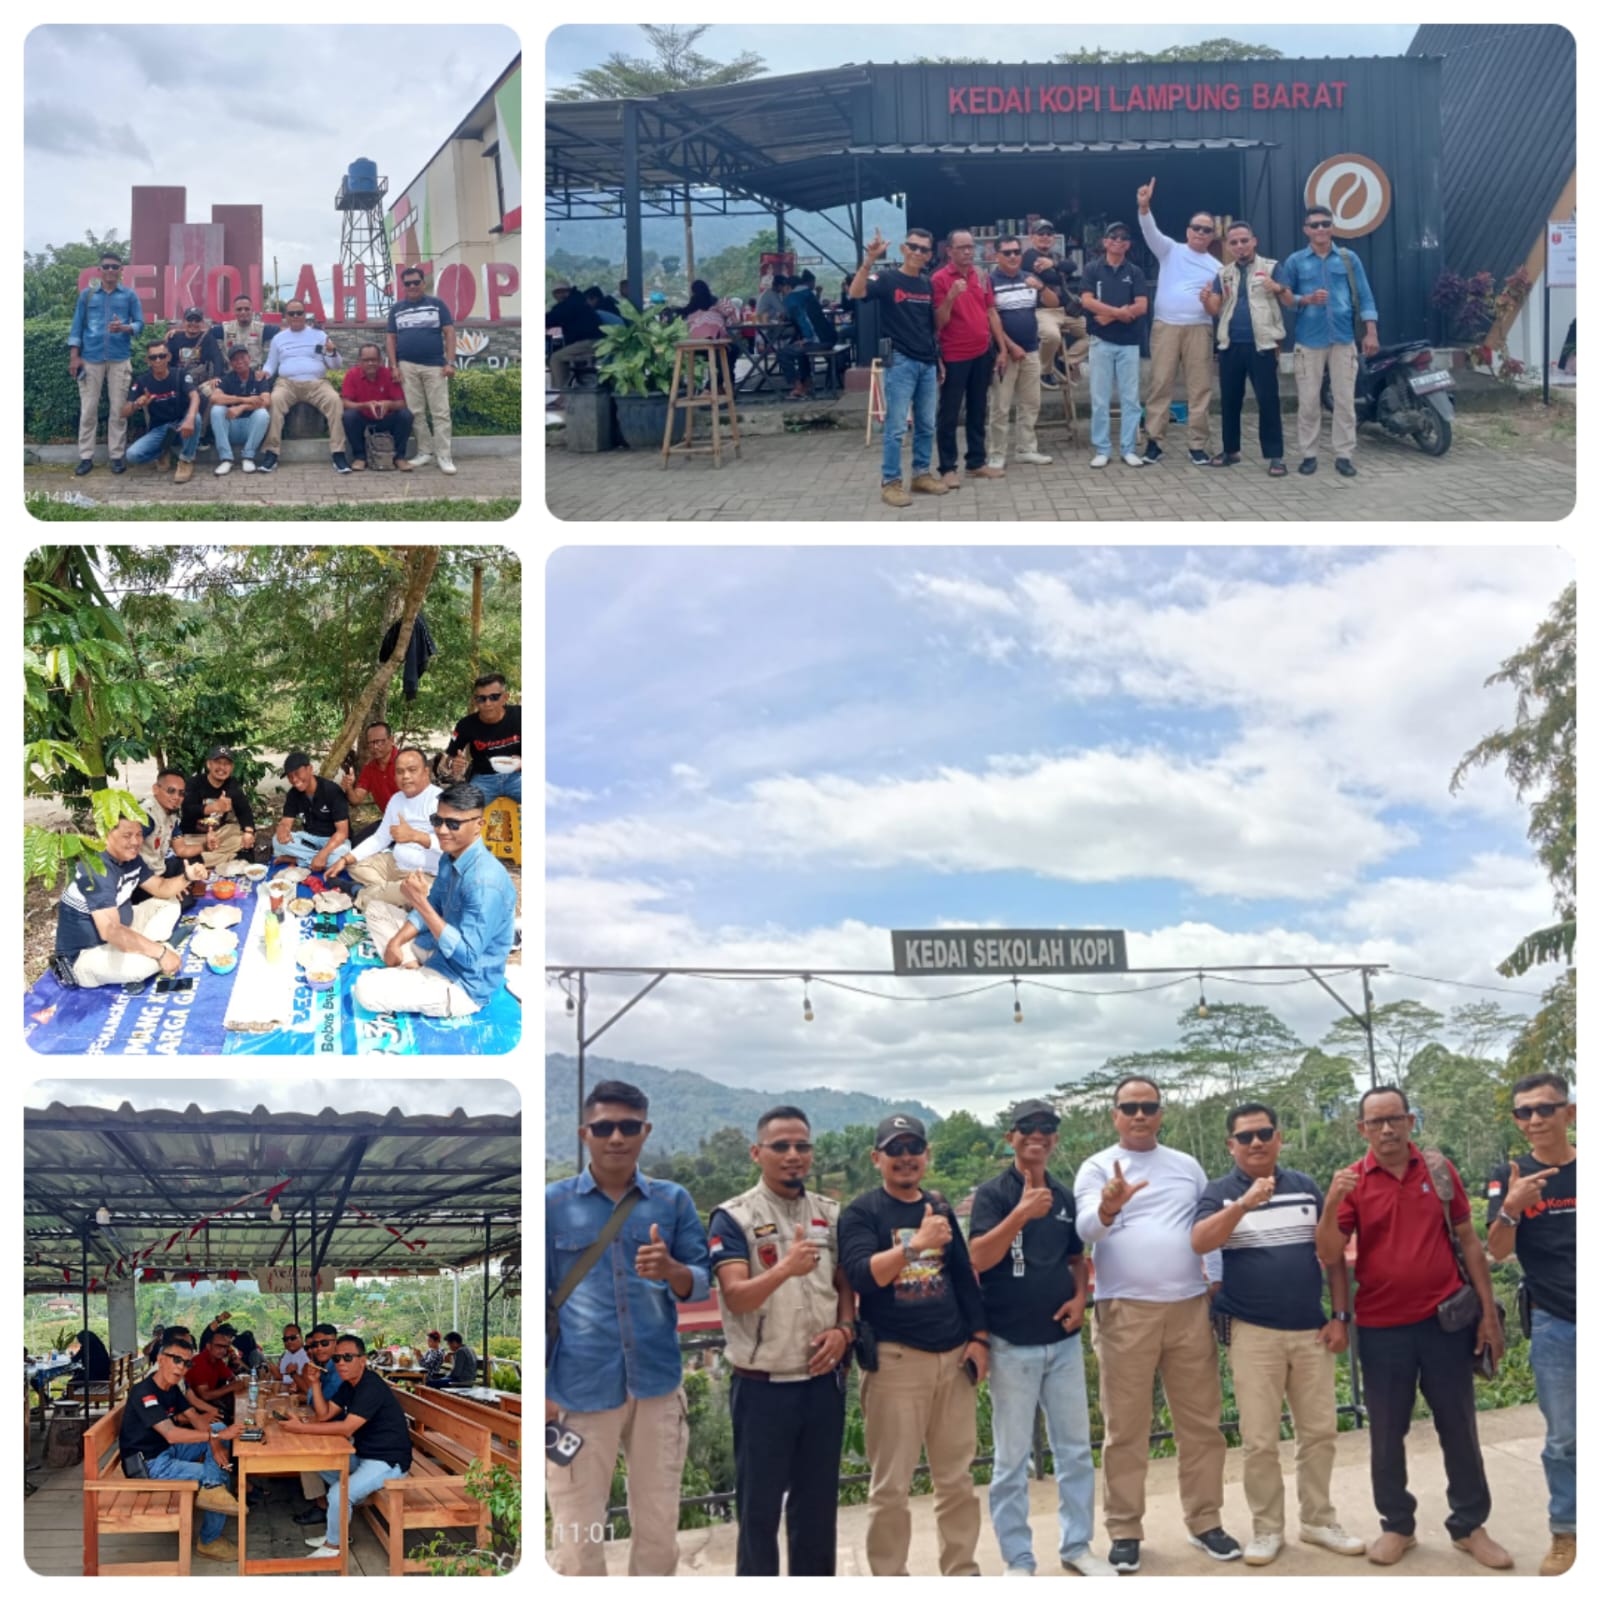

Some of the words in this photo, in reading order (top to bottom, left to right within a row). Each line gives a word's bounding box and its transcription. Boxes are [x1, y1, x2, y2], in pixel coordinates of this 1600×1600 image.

[948, 86, 1032, 115] KEDAI
[1038, 85, 1100, 114] KOPI
[1108, 83, 1241, 112] LAMPUNG
[1251, 81, 1348, 110] BARAT
[905, 939, 968, 969] KEDAI
[973, 938, 1064, 968] SEKOLAH
[1070, 937, 1115, 965] KOPI
[1011, 1230, 1025, 1277] EIGE
